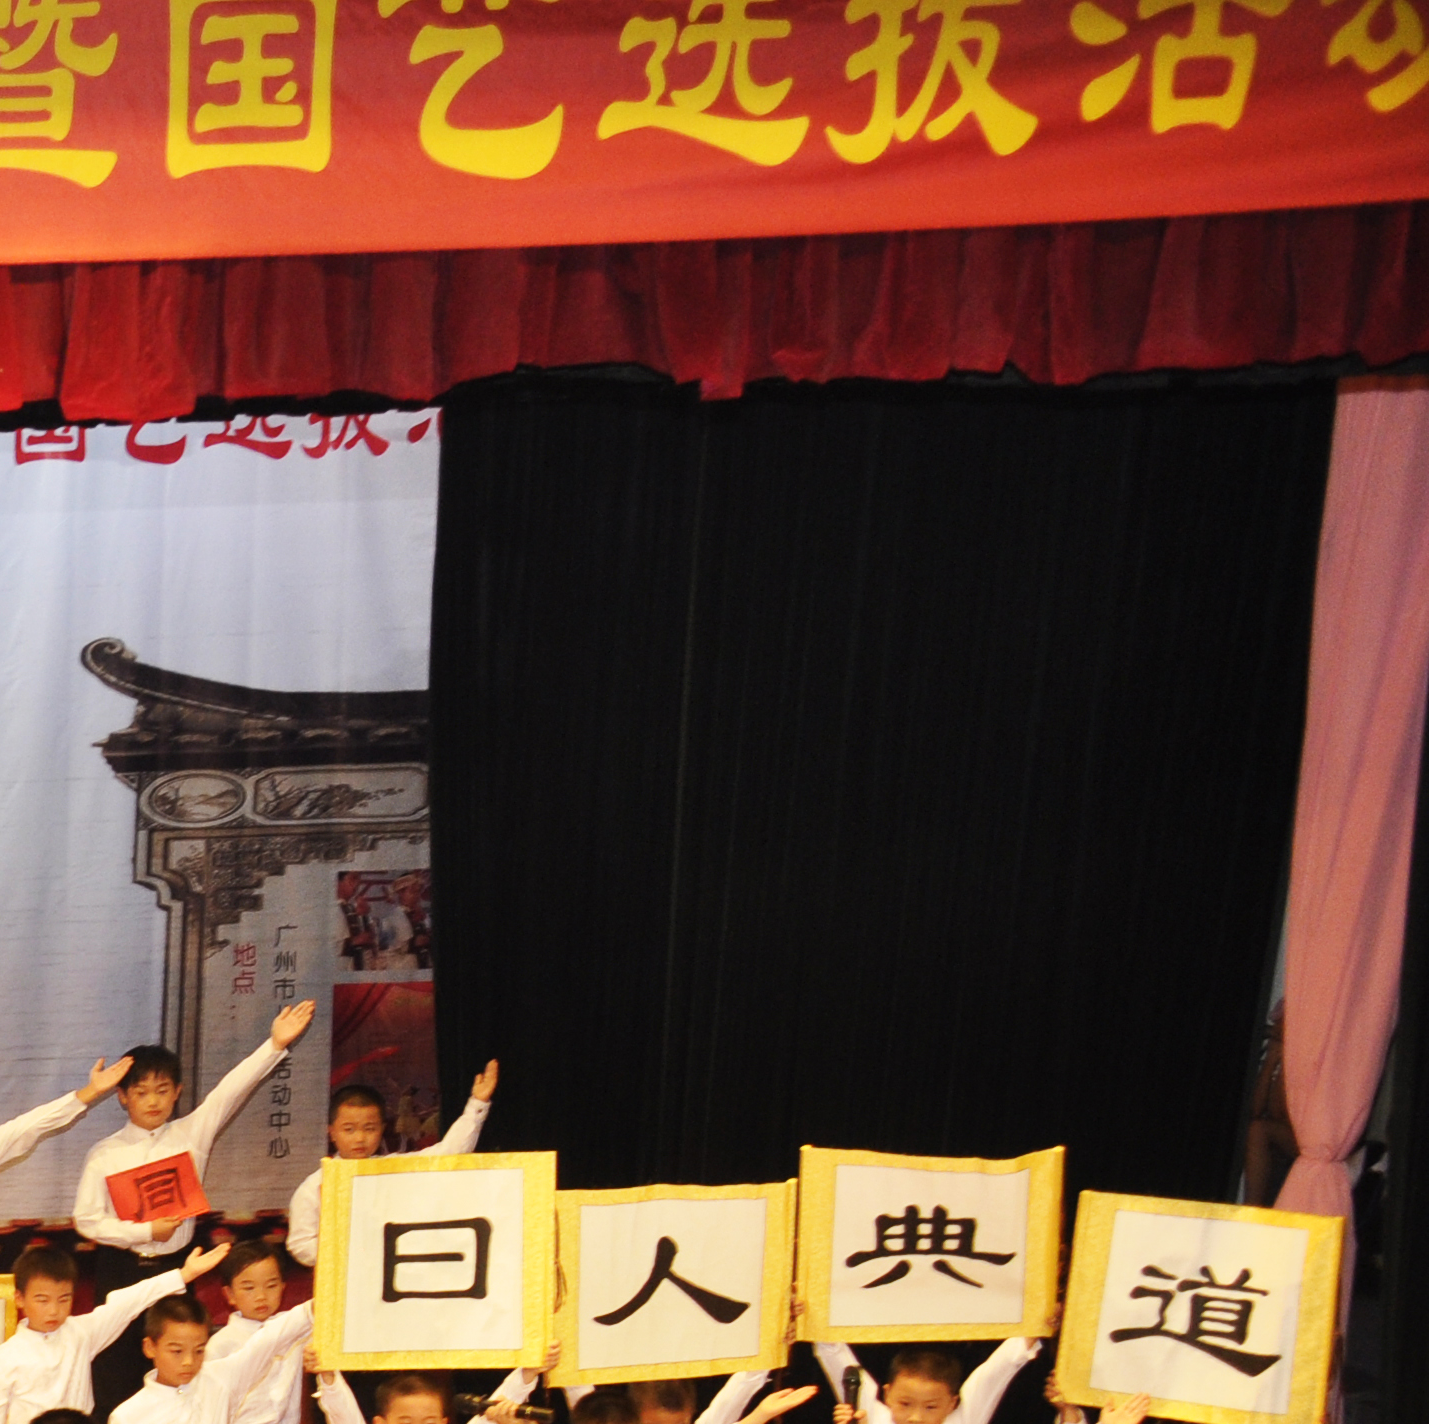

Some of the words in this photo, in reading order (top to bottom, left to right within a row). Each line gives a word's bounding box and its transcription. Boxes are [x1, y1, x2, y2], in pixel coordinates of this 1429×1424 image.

[594, 1236, 751, 1324] 人
[845, 1205, 1017, 1289] 典
[1110, 1265, 1282, 1377] 道
